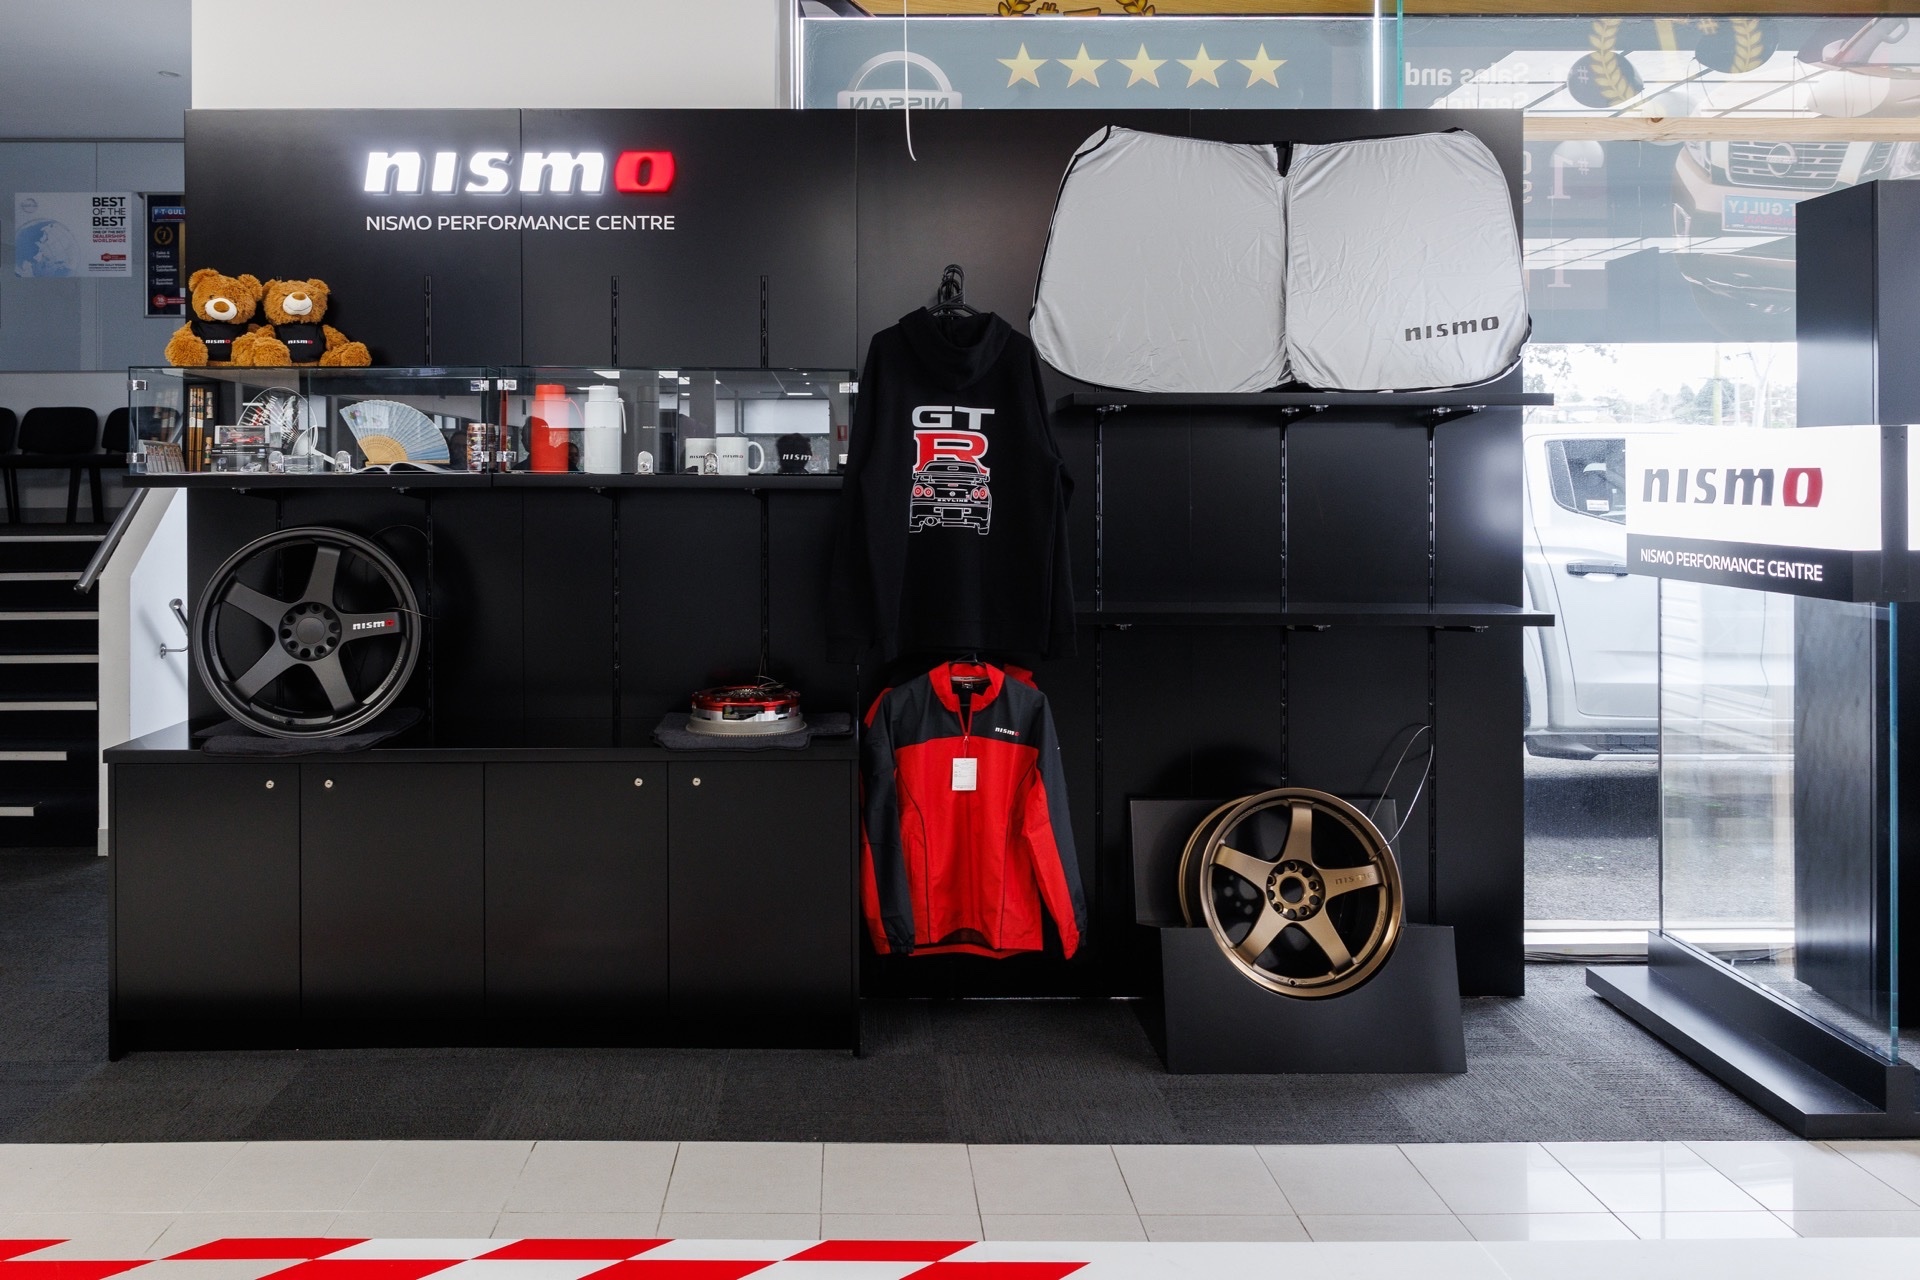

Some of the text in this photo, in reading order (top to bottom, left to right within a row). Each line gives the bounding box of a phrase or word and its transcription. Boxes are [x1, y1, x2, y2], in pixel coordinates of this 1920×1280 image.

[363, 151, 676, 196] nismo
[92, 196, 126, 207] BEST
[92, 216, 126, 227] BEST
[366, 215, 675, 231] NISMO PERFORMANCE CENTRE
[1404, 316, 1499, 341] nismo
[911, 405, 995, 430] GT
[912, 429, 990, 475] R
[1642, 467, 1823, 508] nismo
[1640, 548, 1823, 581] NISMO PERFORMANCE CENTRE
[352, 619, 395, 630] nismo
[994, 726, 1020, 737] nismo
